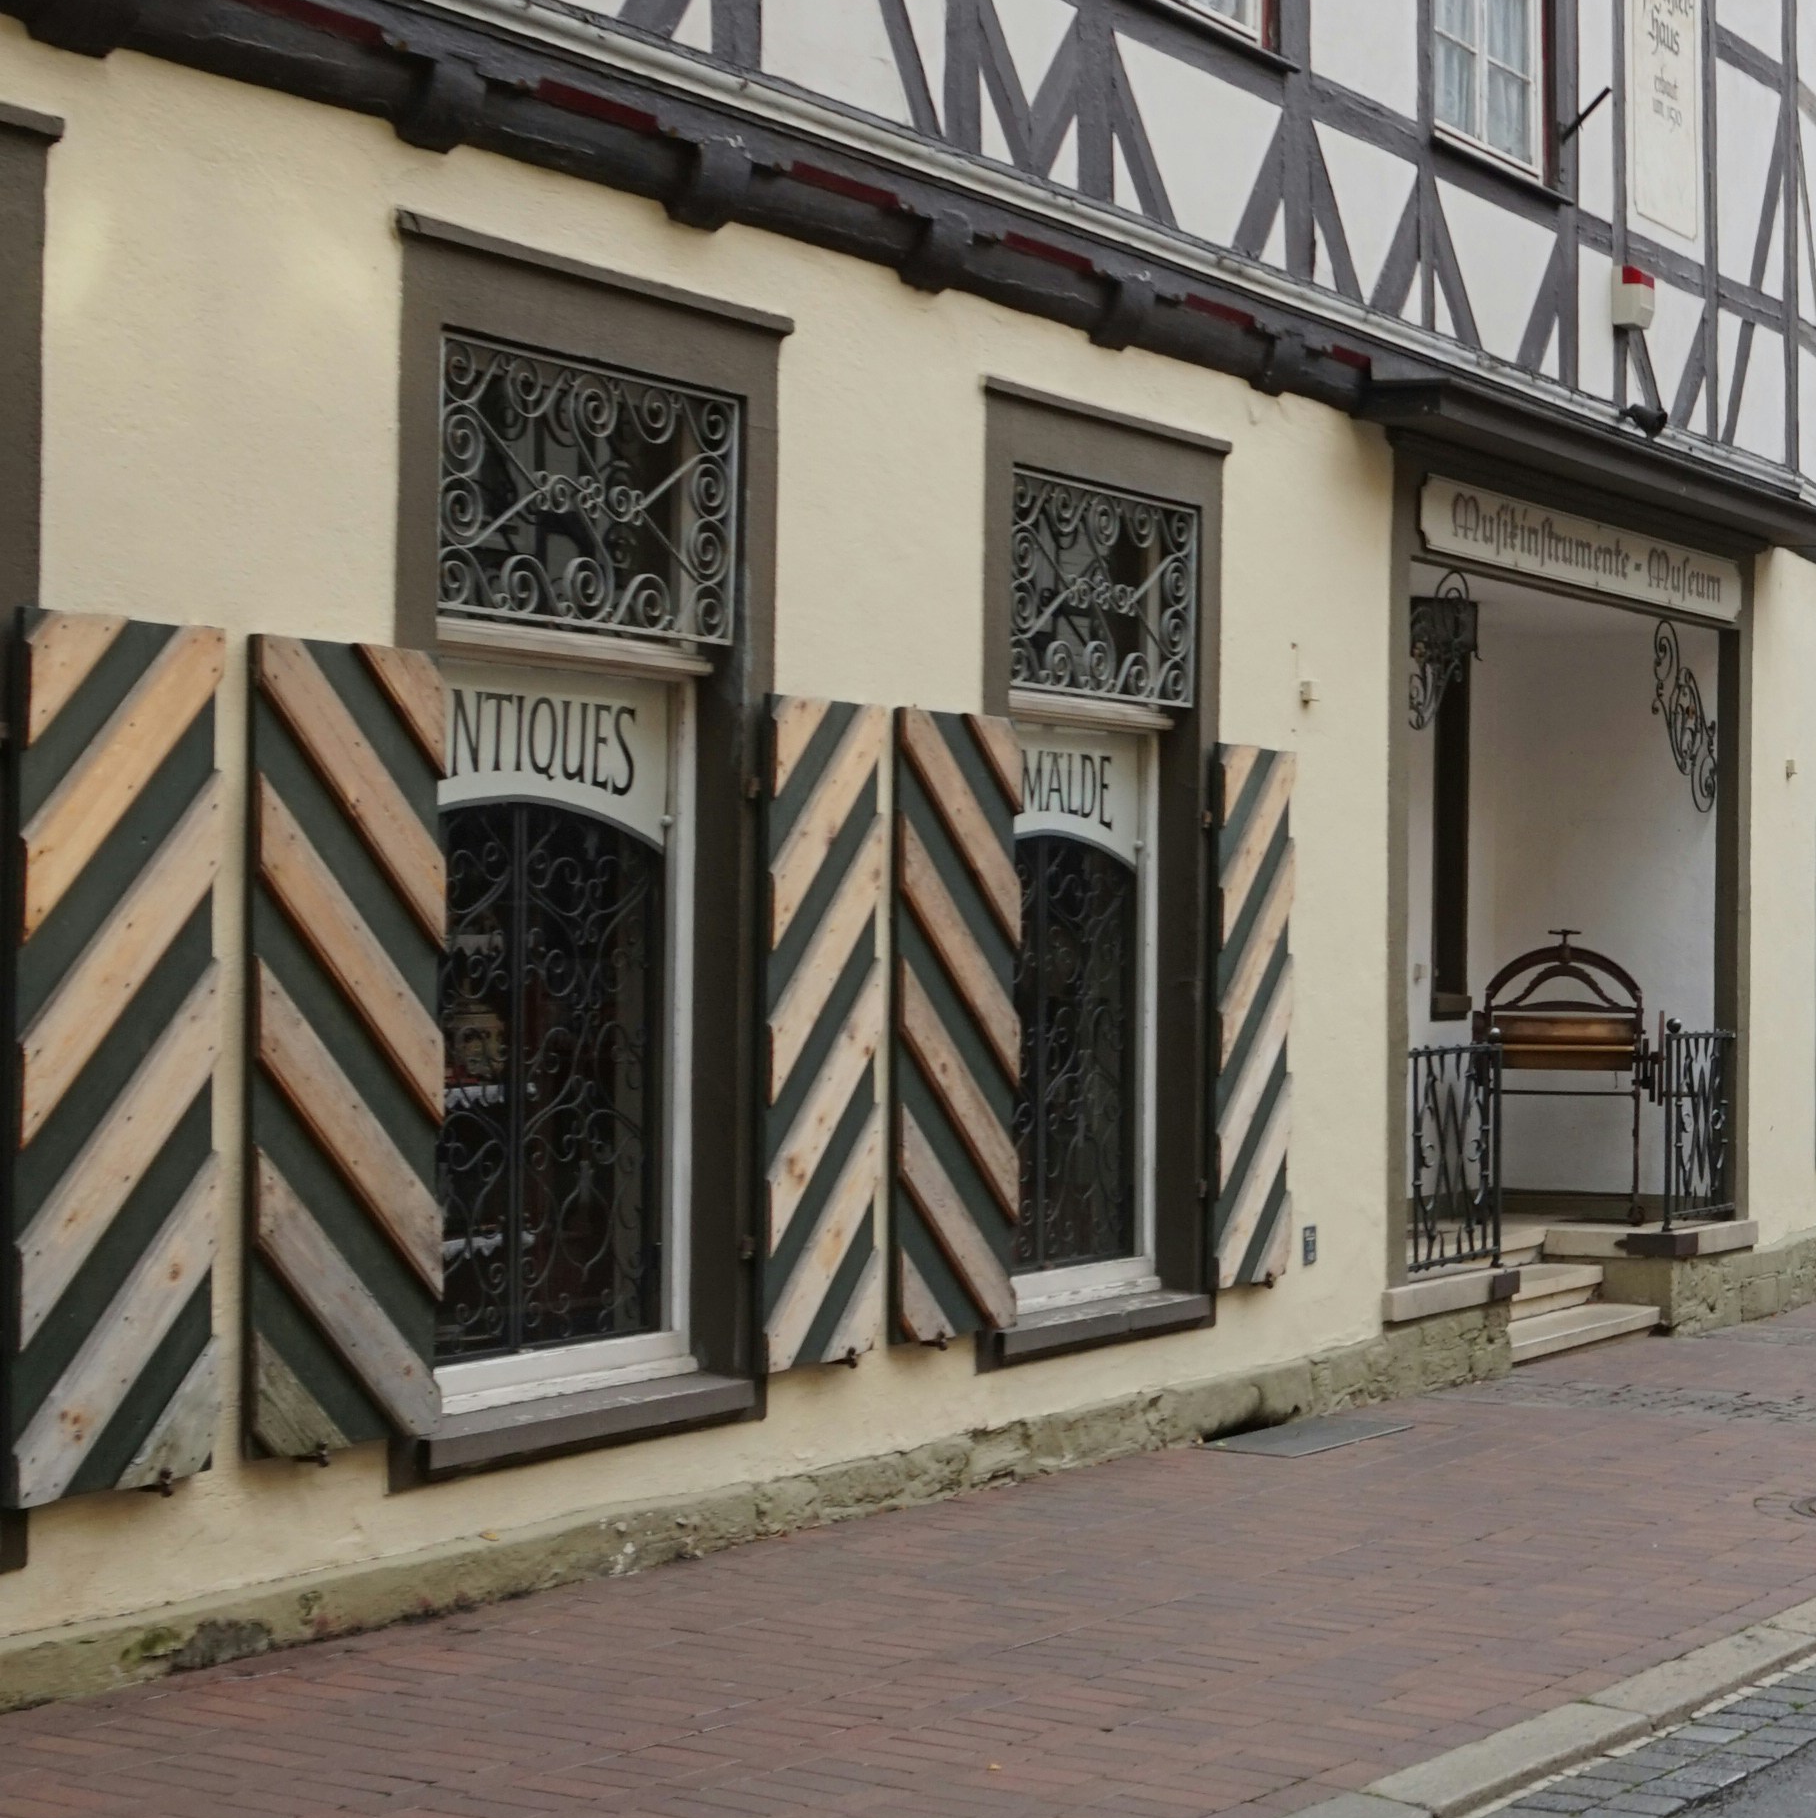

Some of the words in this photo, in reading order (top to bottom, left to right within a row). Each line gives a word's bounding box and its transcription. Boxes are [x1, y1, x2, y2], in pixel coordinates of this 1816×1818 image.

[1648, 4, 1680, 57] Haus
[1647, 547, 1721, 603] Museum
[452, 688, 636, 796] NTIQUES
[1020, 749, 1112, 831] MÄLDE
